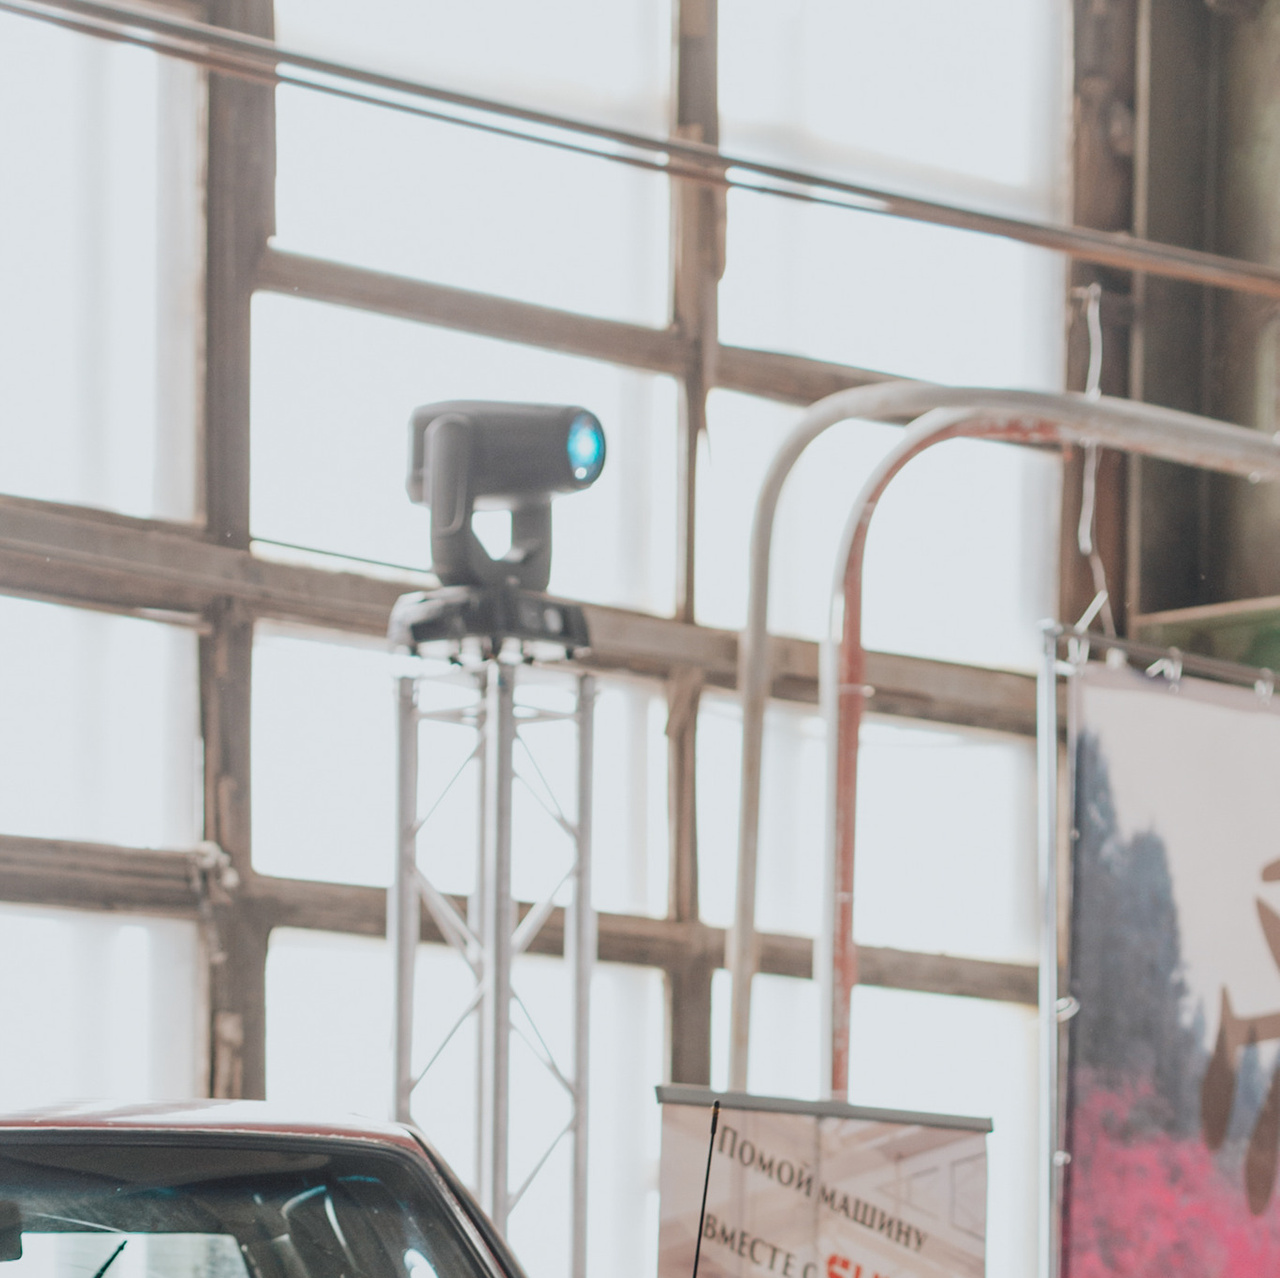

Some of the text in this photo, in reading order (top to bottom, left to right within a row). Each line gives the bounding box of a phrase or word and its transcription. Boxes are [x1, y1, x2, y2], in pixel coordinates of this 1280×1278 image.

[718, 1125, 928, 1251] ПОМОЙ МАШИНУ
[703, 1213, 796, 1278] ВМЕСТЕ
